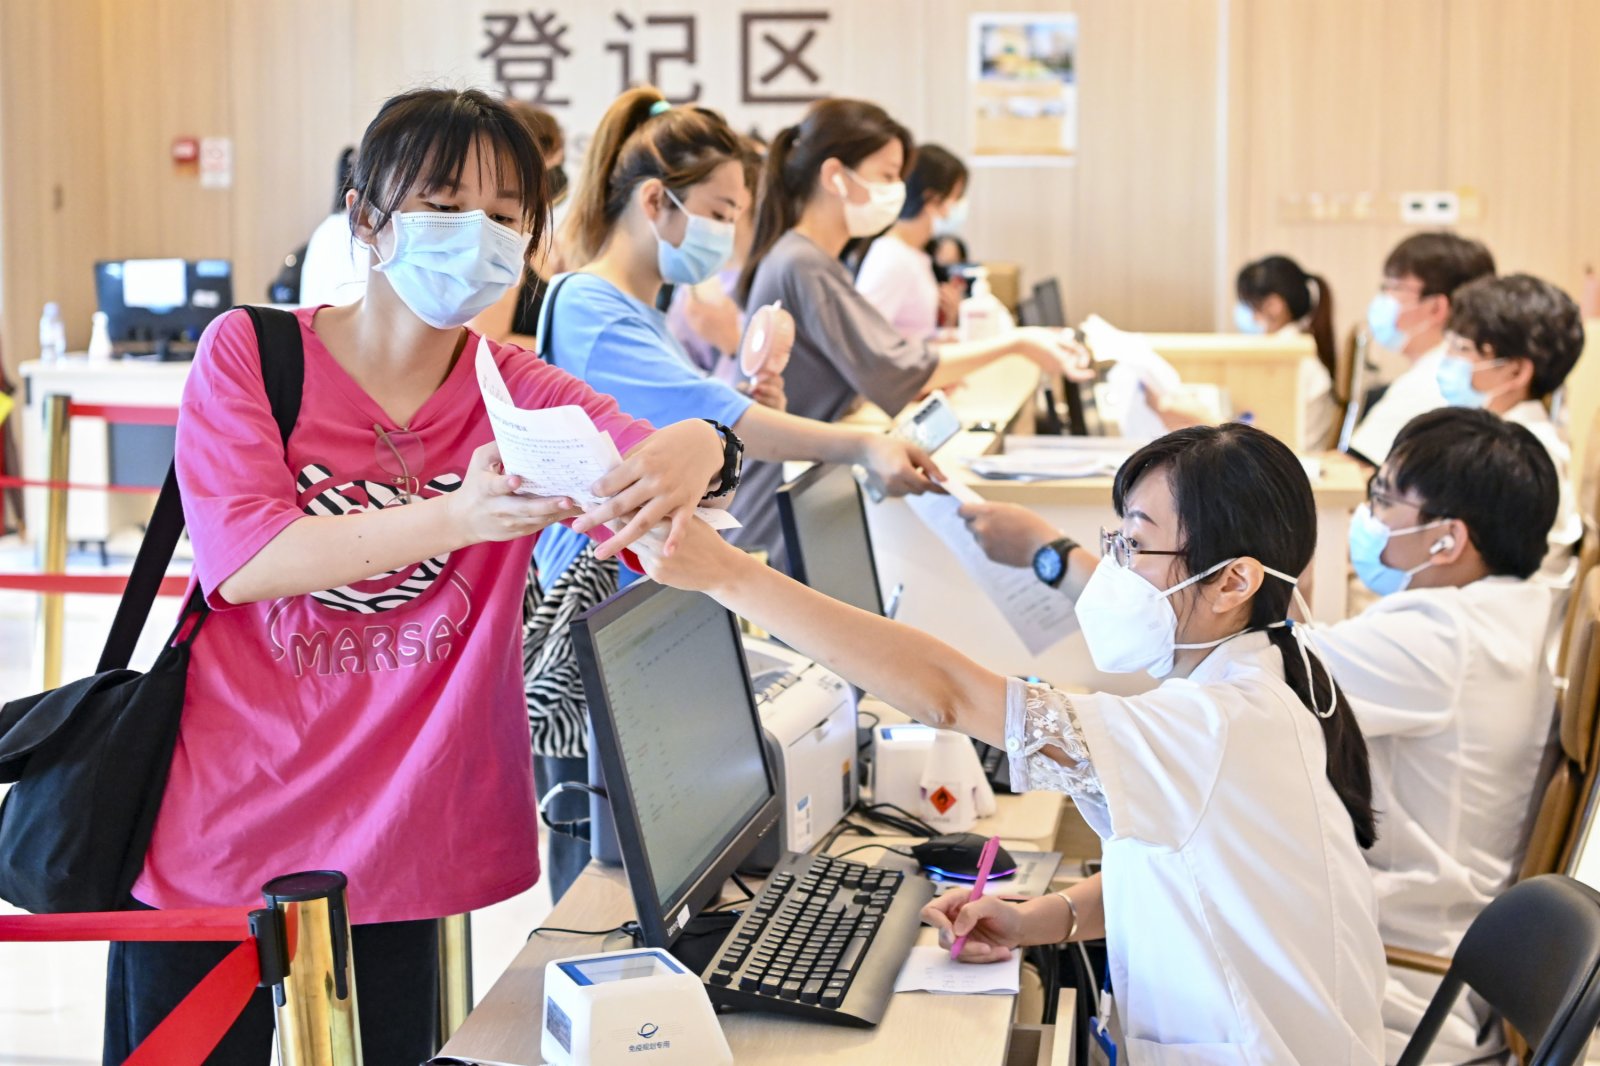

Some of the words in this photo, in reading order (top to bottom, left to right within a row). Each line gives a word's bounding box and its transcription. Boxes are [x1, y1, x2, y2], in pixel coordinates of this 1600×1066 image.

[480, 10, 830, 105] 登记区
[287, 614, 456, 678] MARSA
